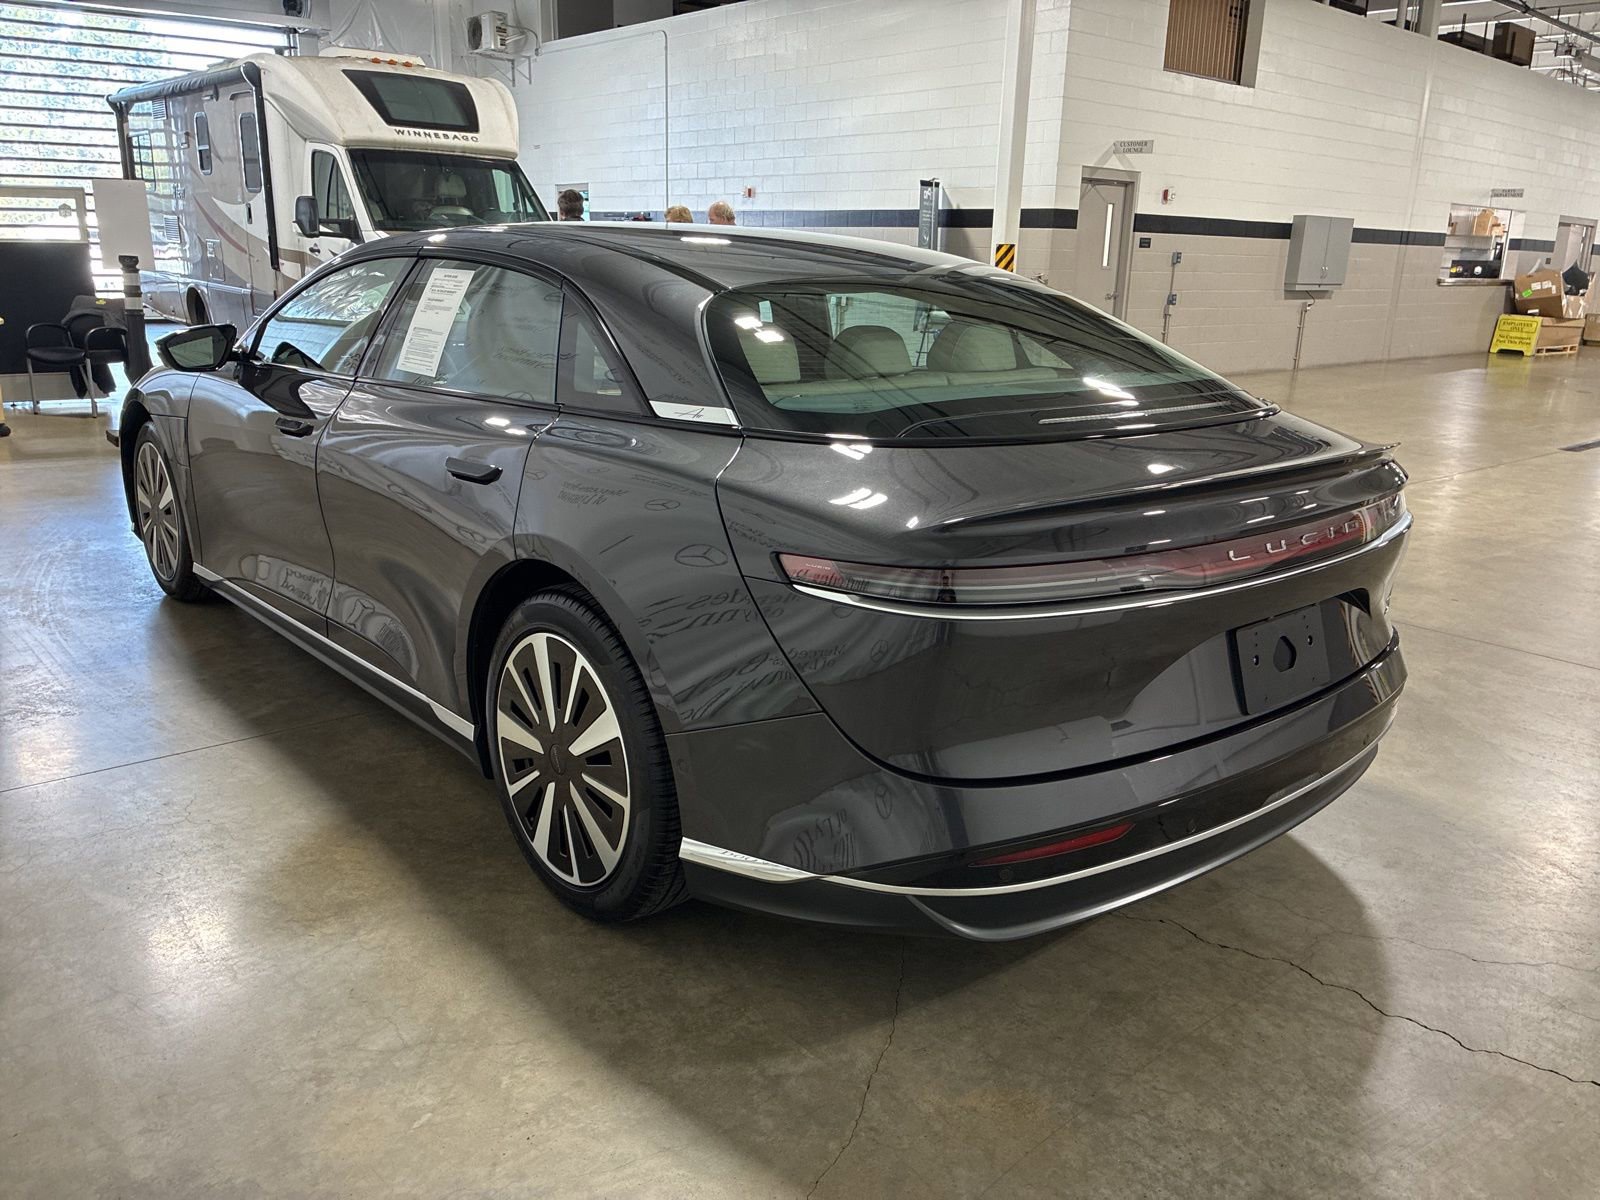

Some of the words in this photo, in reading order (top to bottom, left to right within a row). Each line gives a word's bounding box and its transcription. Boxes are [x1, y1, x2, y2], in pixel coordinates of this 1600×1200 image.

[394, 128, 479, 143] WINNEBAGO
[674, 407, 705, 418] Air
[1228, 521, 1359, 561] LUCID
